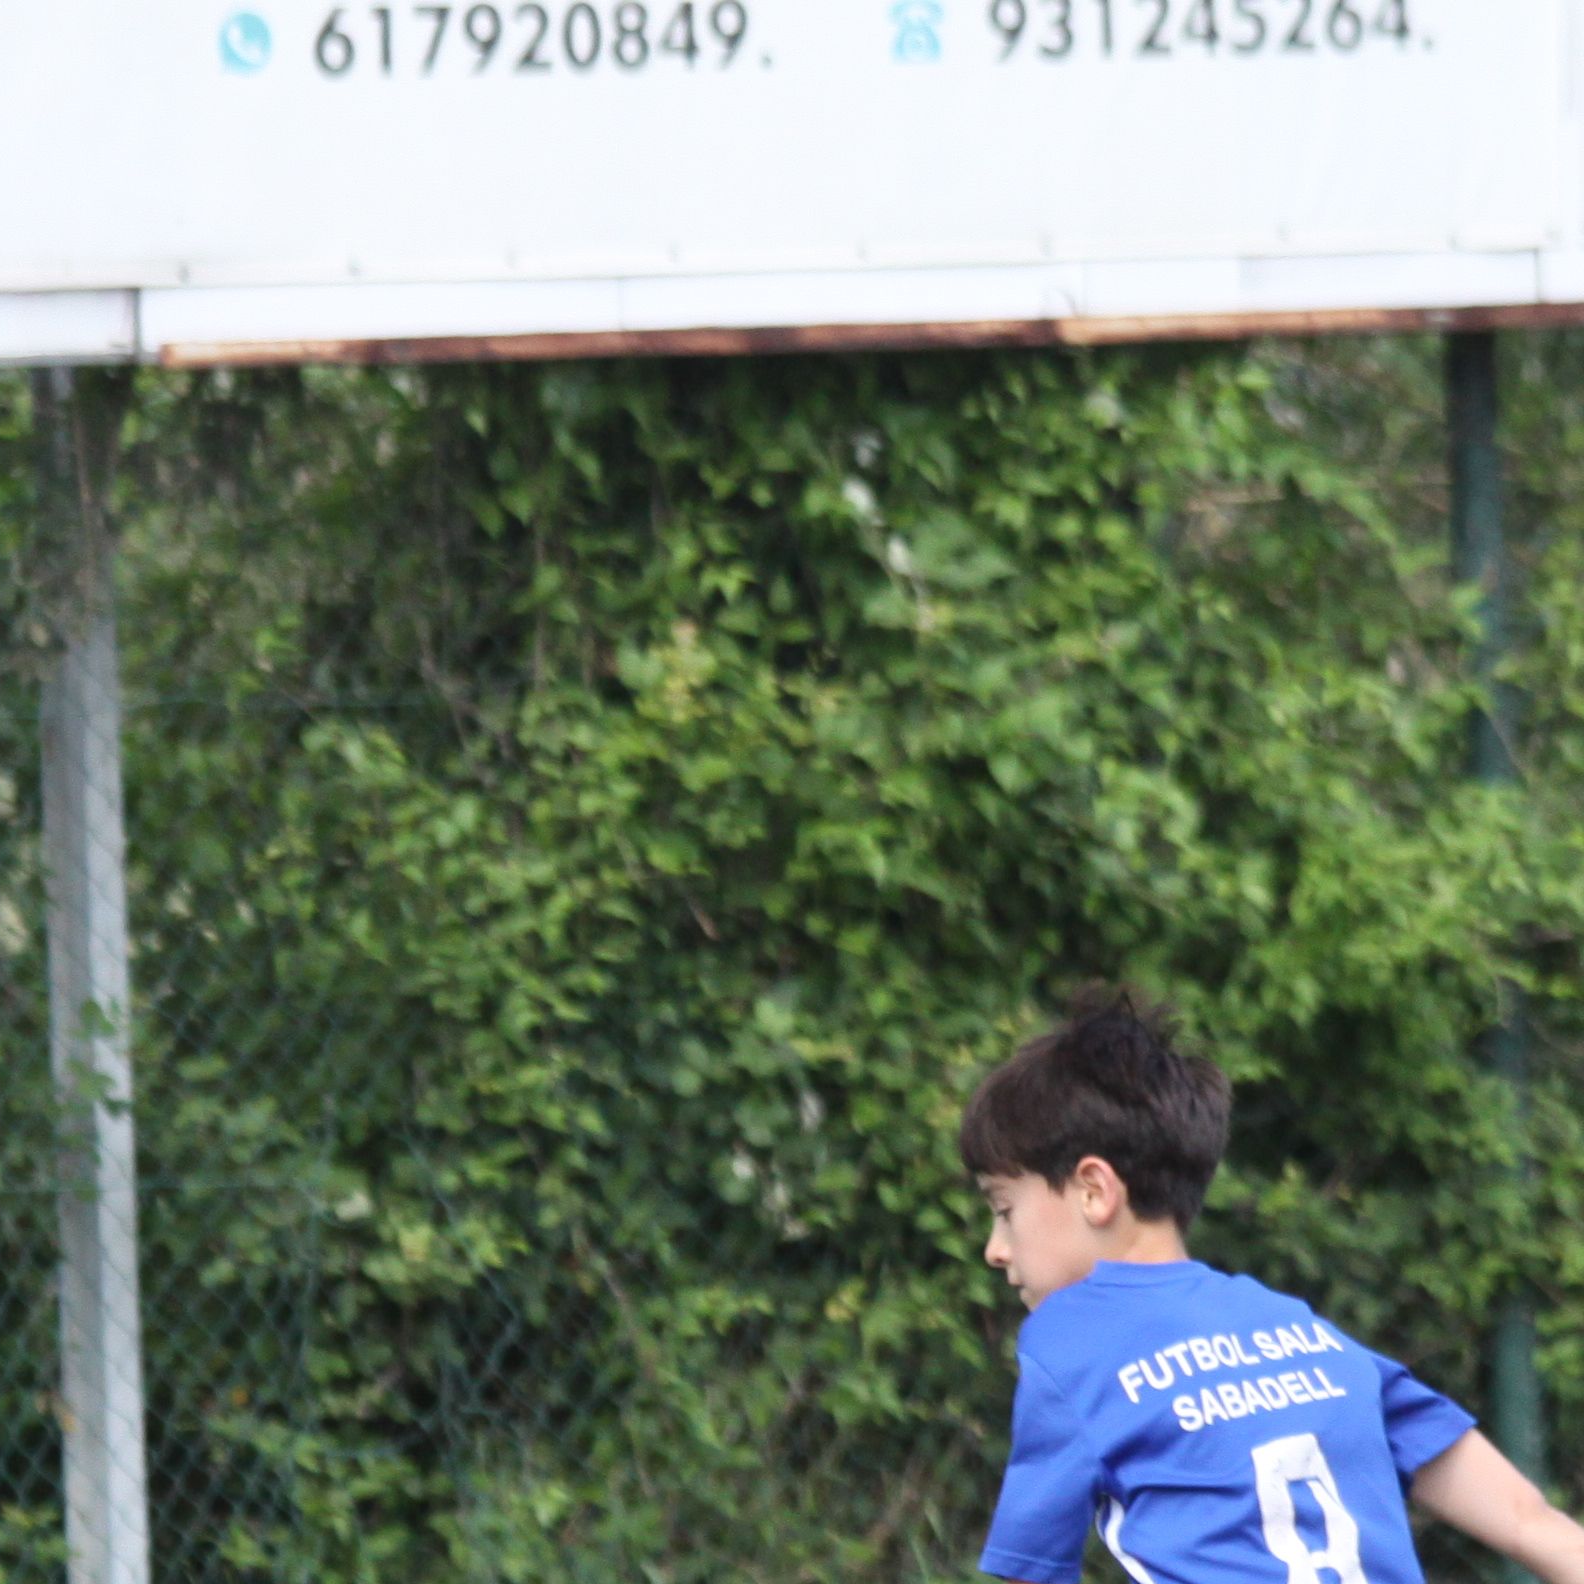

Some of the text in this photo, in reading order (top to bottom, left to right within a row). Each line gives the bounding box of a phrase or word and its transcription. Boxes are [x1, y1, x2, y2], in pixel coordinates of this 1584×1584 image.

[314, 0, 772, 77] 617920849.
[1117, 1322, 1344, 1404] FUTBOL SALA
[1172, 1367, 1346, 1432] SABADELL
